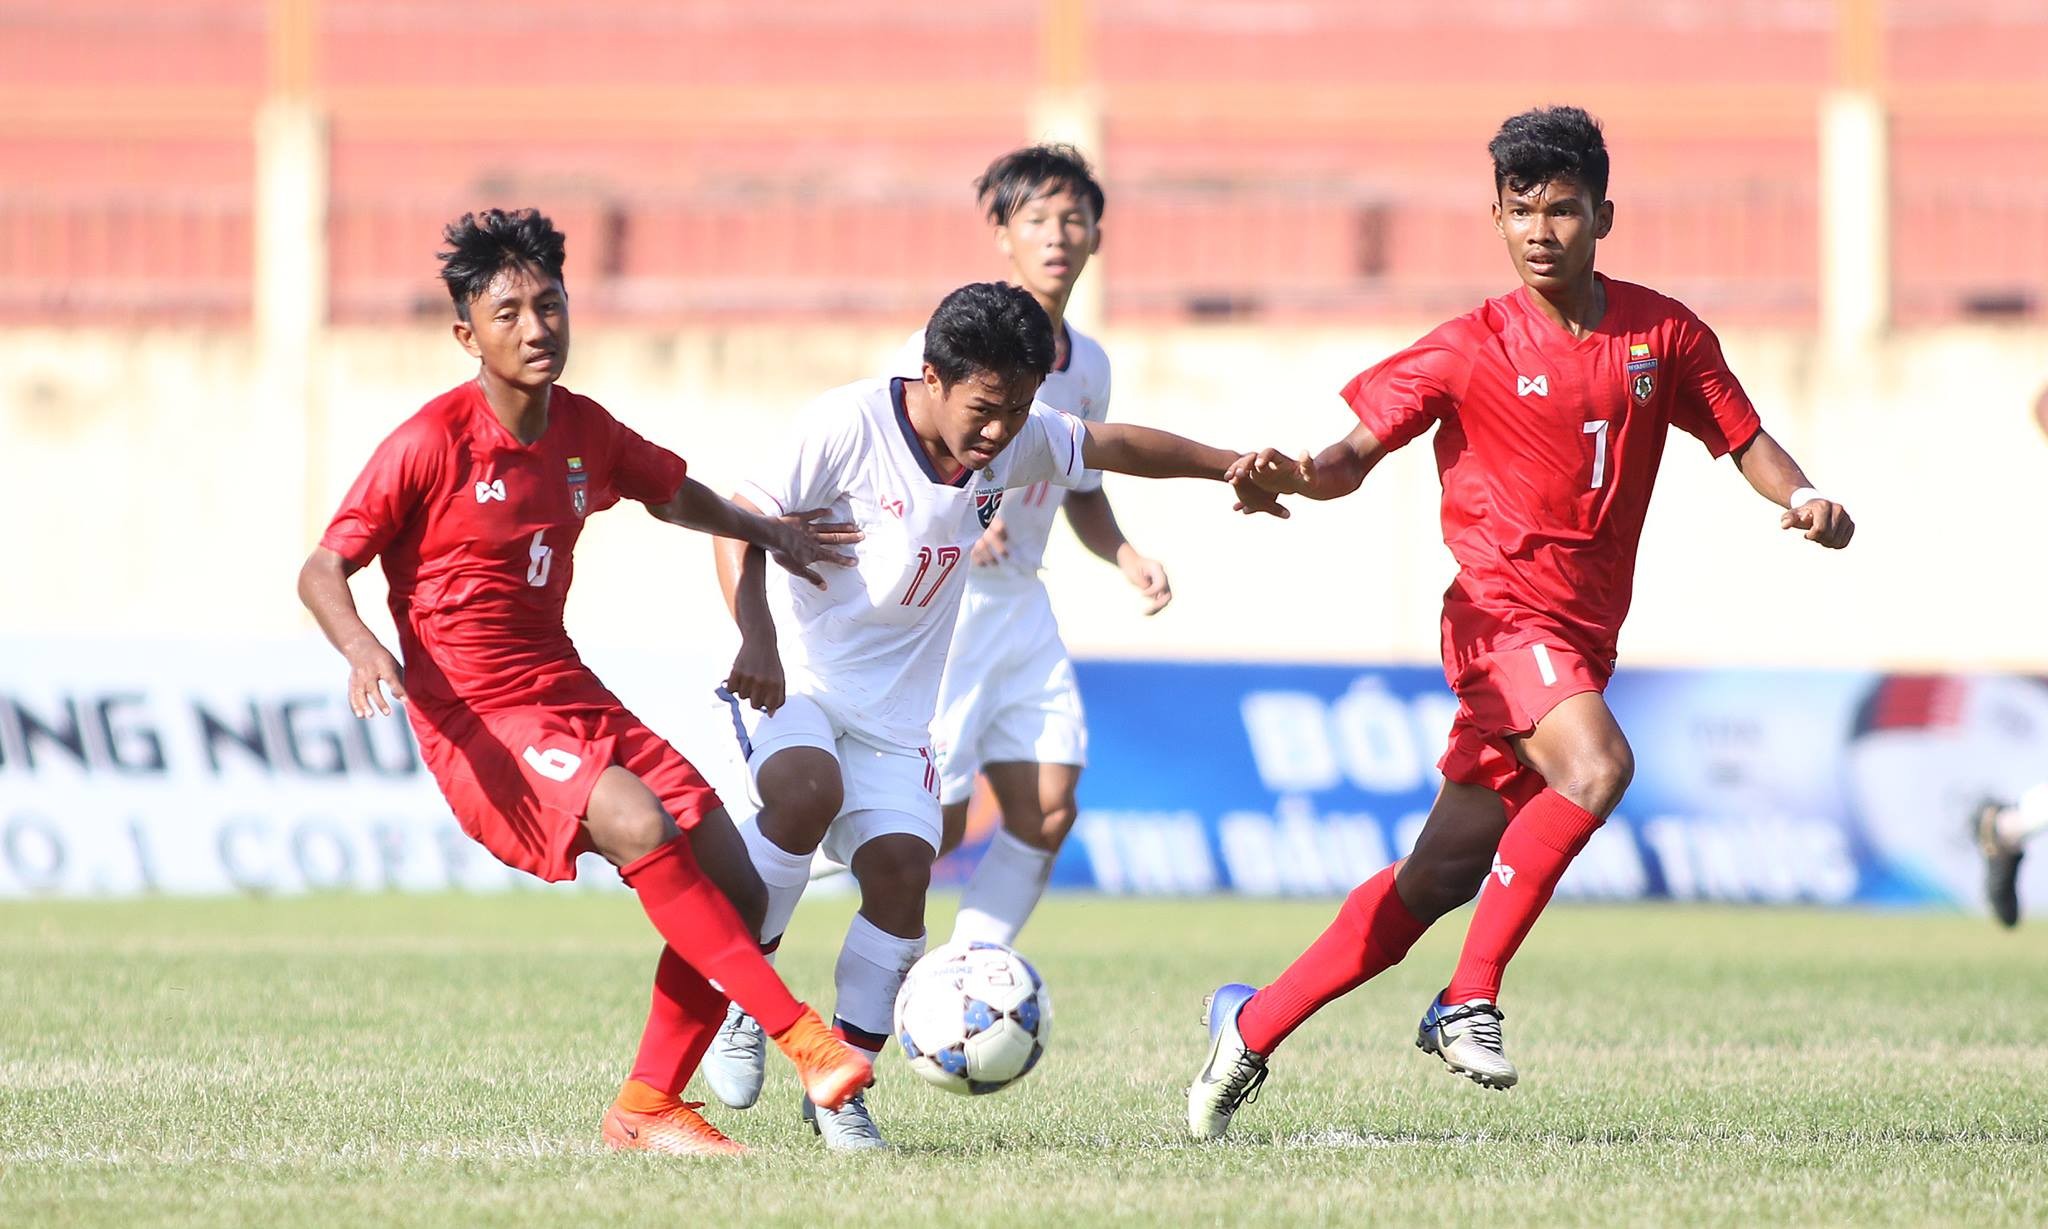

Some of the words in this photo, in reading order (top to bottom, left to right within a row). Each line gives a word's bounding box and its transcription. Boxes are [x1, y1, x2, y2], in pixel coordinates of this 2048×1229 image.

[1583, 420, 1609, 489] 7
[527, 527, 553, 587] 6
[900, 546, 961, 608] 17
[0, 692, 166, 774] NG
[522, 745, 582, 783] 6
